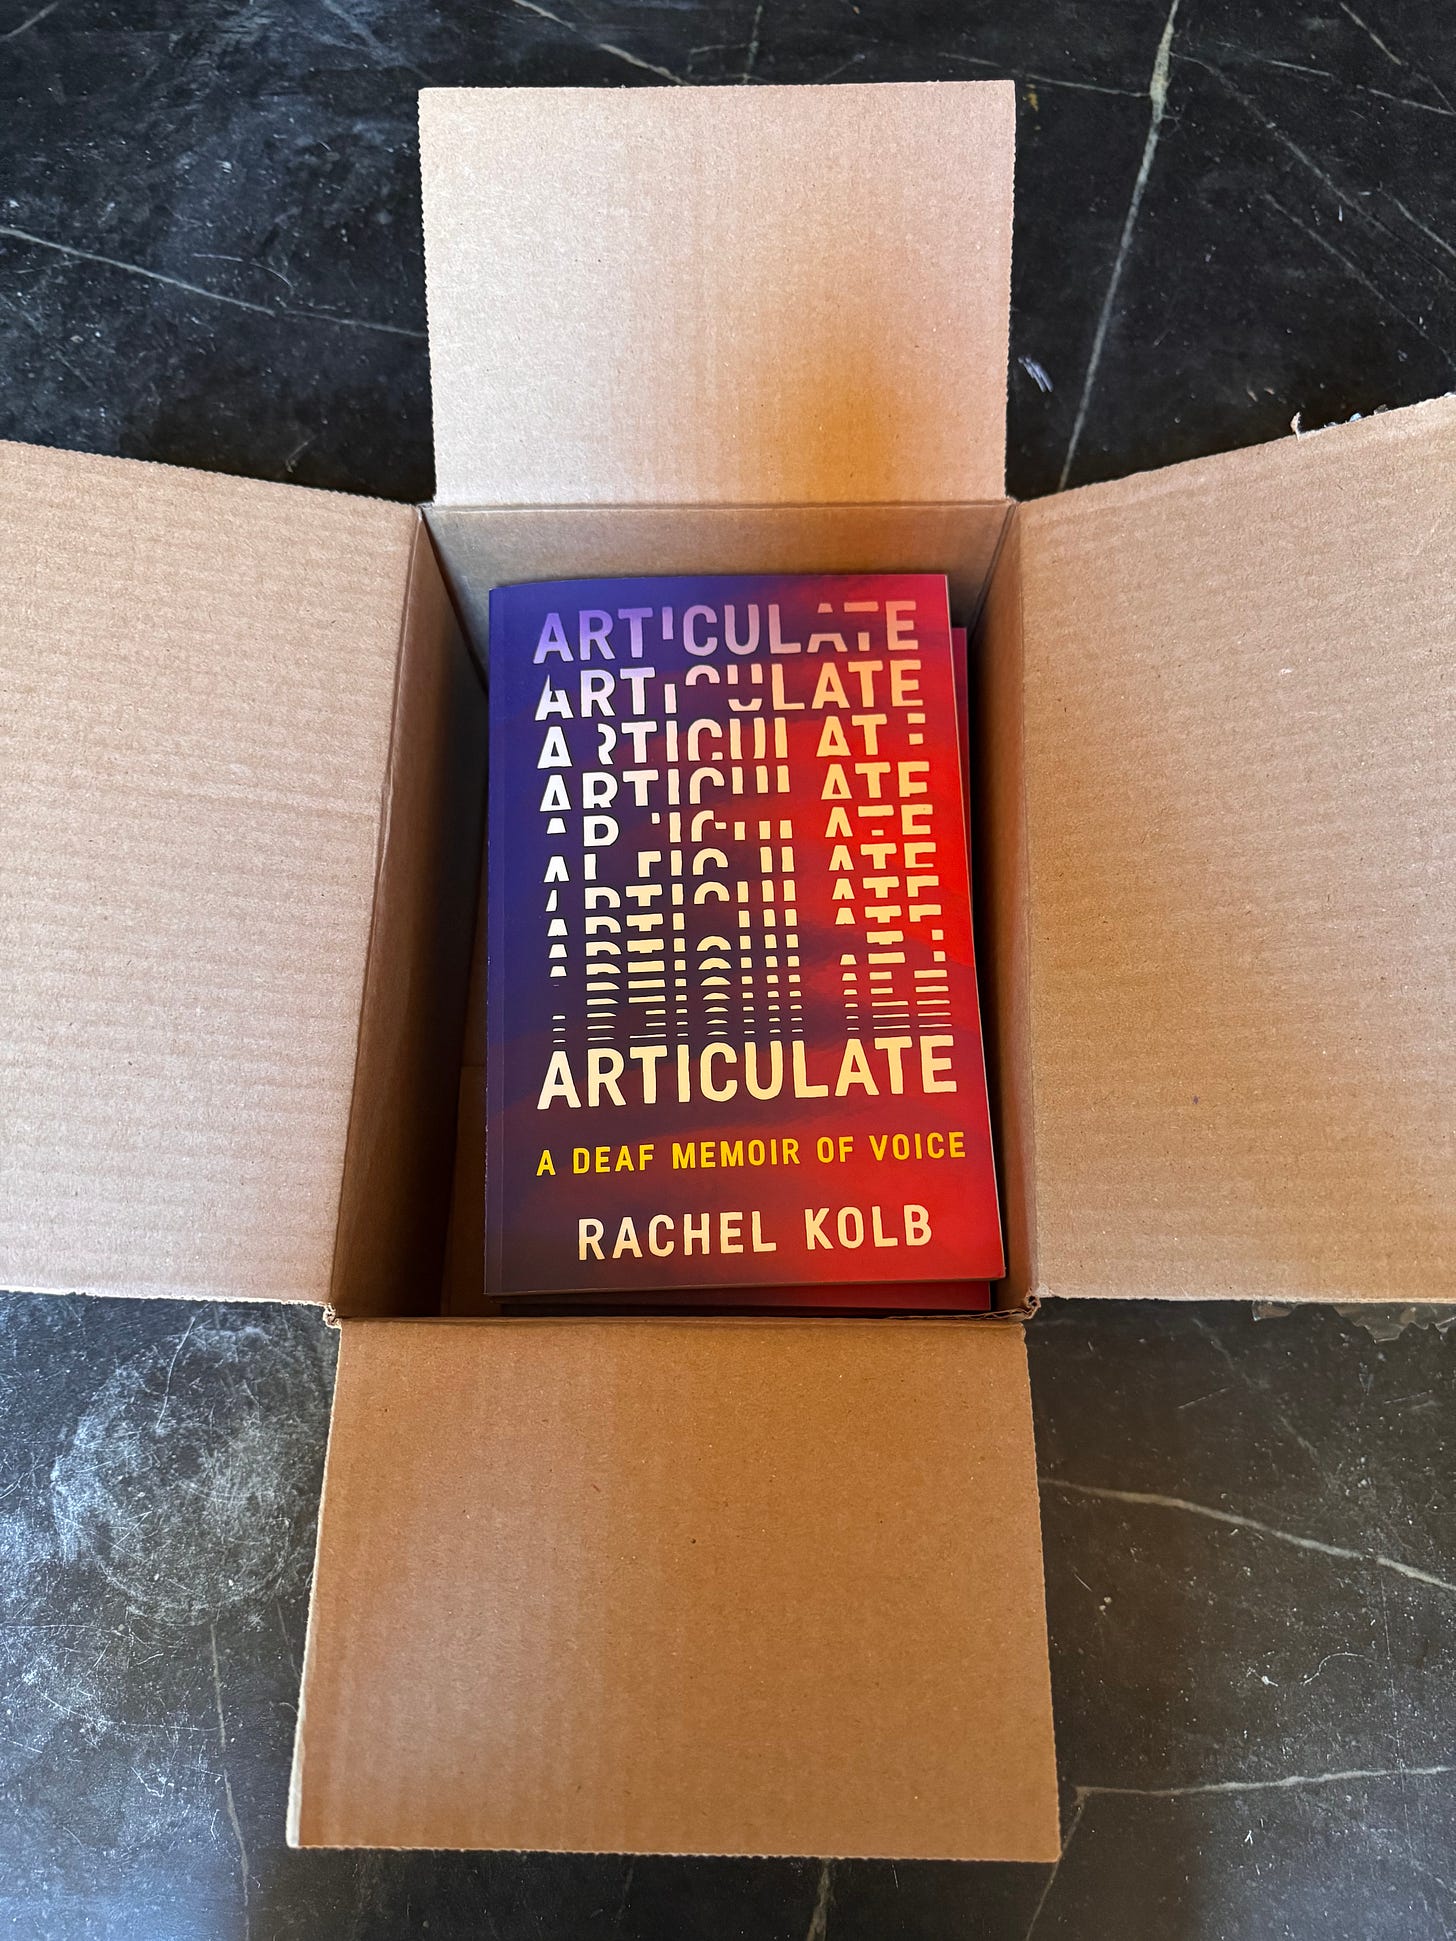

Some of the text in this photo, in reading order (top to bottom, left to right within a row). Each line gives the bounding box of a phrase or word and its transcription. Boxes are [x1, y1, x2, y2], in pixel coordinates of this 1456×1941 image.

[533, 600, 919, 664] ARTICULATE
[536, 1035, 958, 1110] ARTICULATE
[536, 1131, 966, 1176] A DEAF MEMOIR OF VOICE
[578, 1204, 933, 1261] RACHEL KOLB
